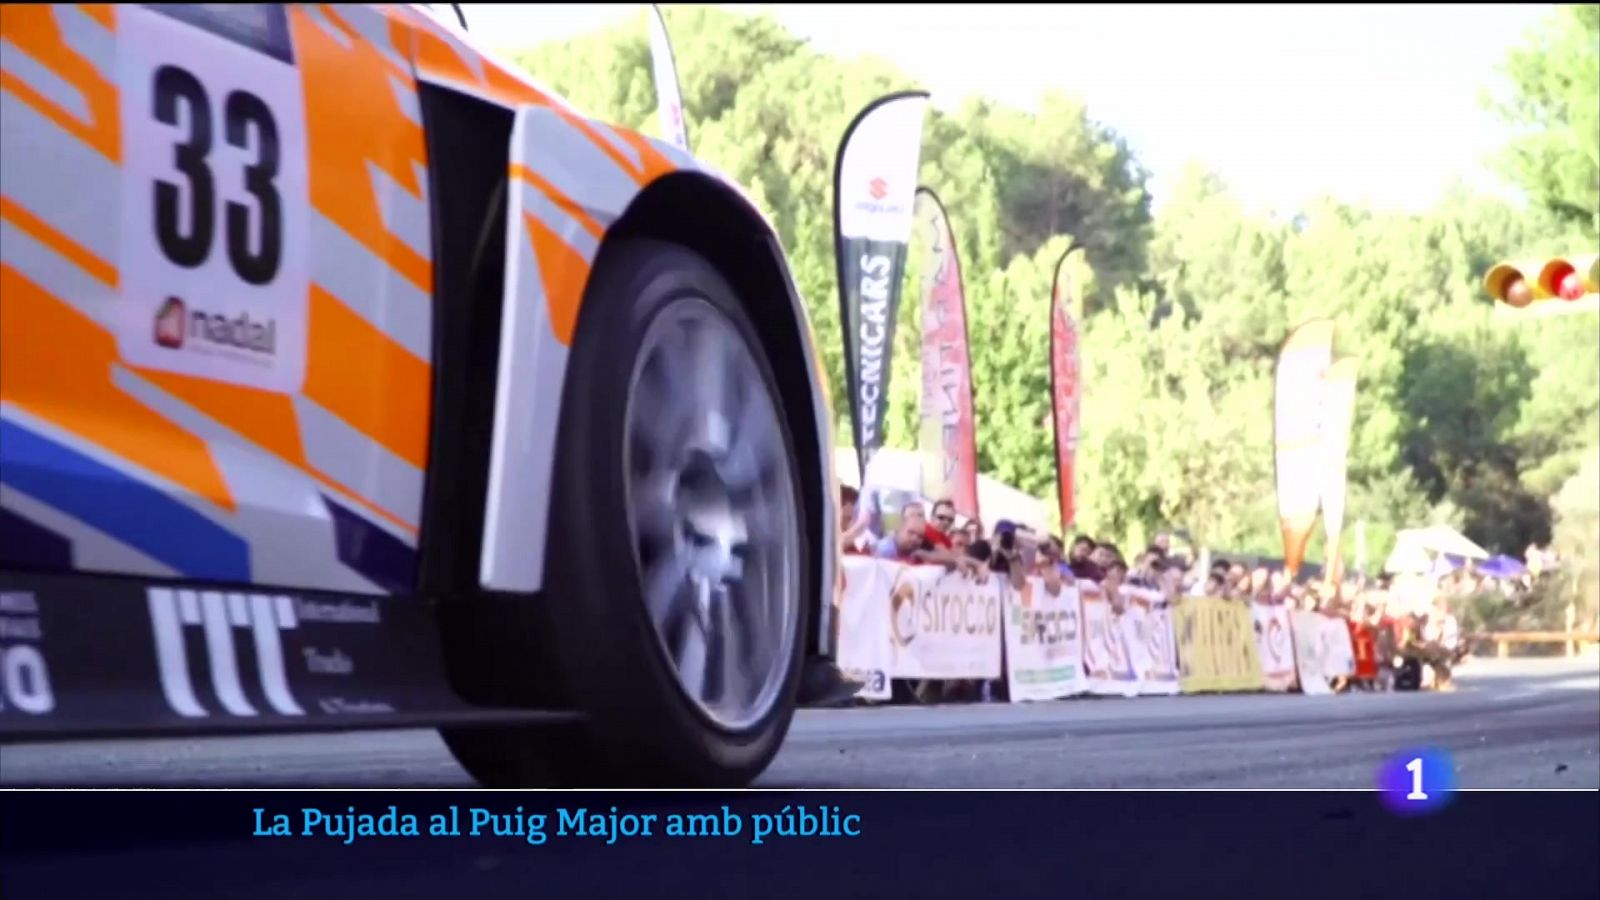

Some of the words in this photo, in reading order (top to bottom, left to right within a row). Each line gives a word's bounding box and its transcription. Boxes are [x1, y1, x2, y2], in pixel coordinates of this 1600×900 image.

[151, 63, 283, 287] 33
[188, 308, 277, 356] nadal
[857, 252, 892, 448] TECNICARS
